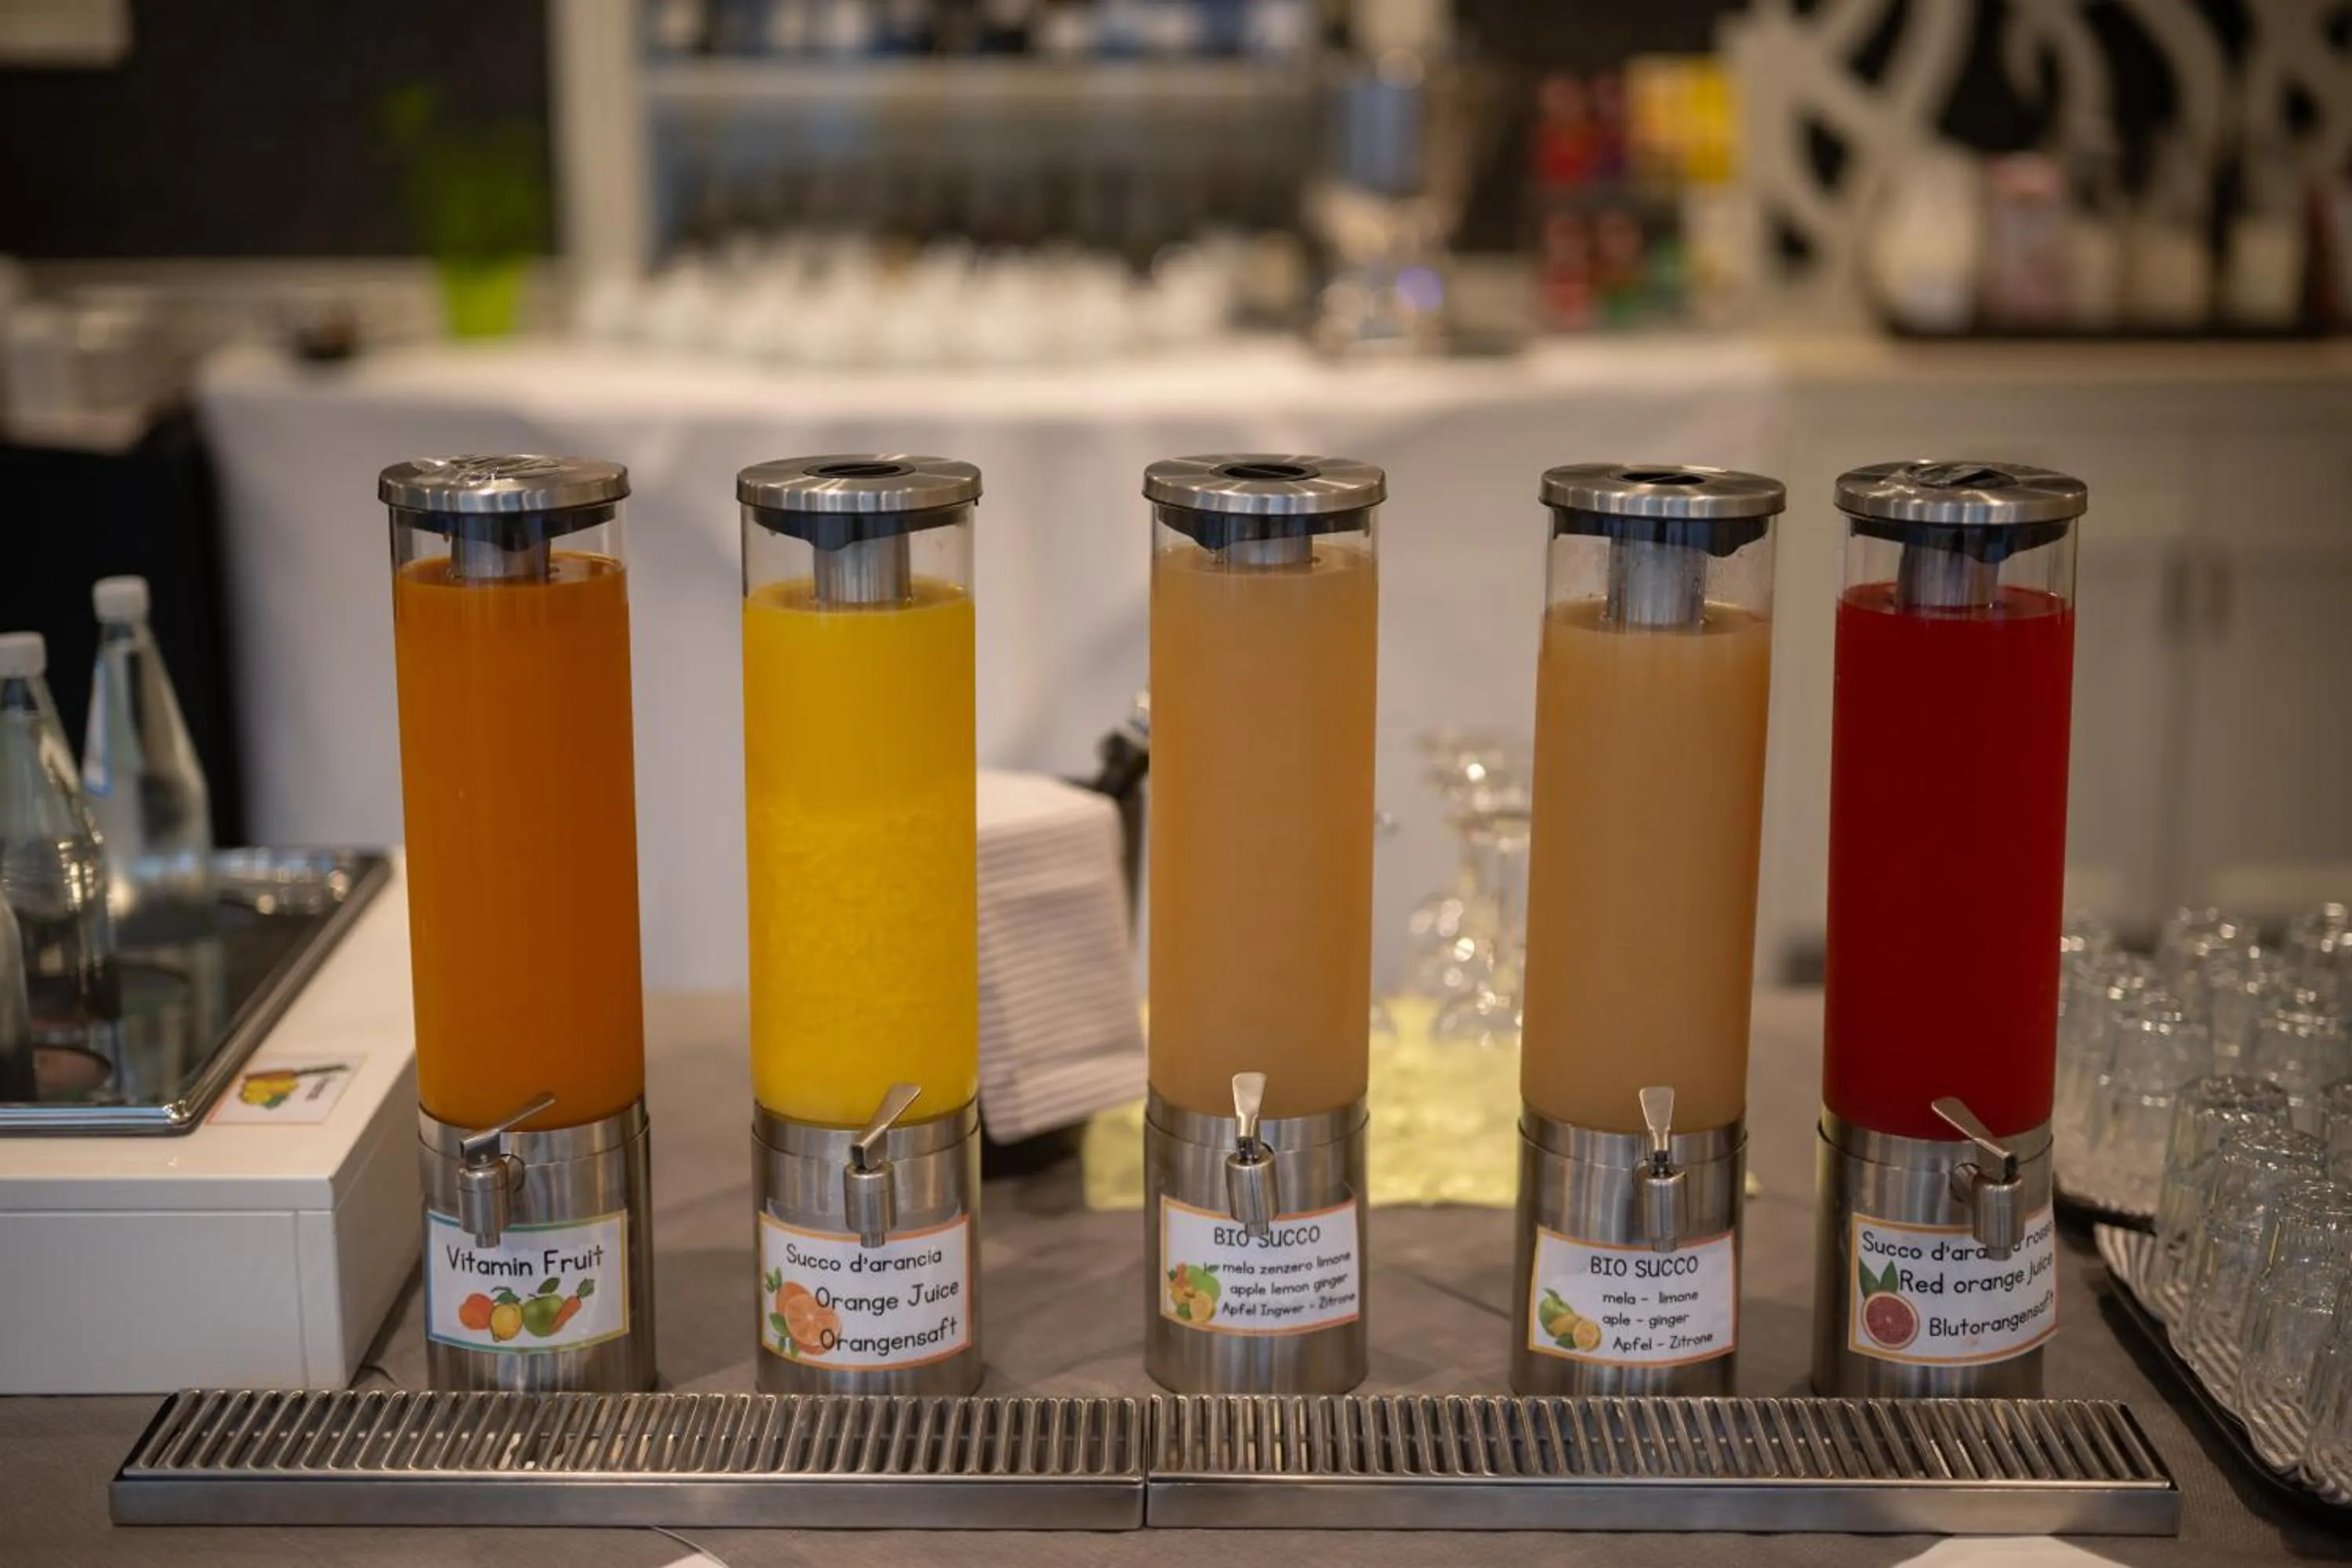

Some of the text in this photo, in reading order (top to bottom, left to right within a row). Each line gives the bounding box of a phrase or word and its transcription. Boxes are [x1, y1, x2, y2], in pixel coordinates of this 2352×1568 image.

[1214, 1226, 1250, 1248] BIO
[1862, 1231, 1922, 1259] Succo
[1931, 1241, 2021, 1261] d'araa
[446, 1244, 604, 1276] Vitamin Fruit
[786, 1243, 942, 1272] Succo d'arancia
[1222, 1252, 1351, 1276] mela zenzero limone
[1590, 1256, 1698, 1278] BIO SUCCO
[1229, 1273, 1348, 1298] apple lemon ginger
[1900, 1269, 1944, 1294] Red
[1954, 1270, 2024, 1293] orange
[815, 1281, 960, 1316] Orange Juice
[1221, 1301, 1257, 1317] Apfel
[1260, 1304, 1304, 1319] Ingwer
[1319, 1293, 1356, 1310] Zitrone
[1602, 1292, 1636, 1305] mela
[1658, 1291, 1699, 1305] limone
[1602, 1312, 1631, 1327] aple
[1649, 1313, 1690, 1329] ginger
[1929, 1290, 2053, 1337] Blutorangensaft
[820, 1316, 957, 1356] Orangensaft
[1613, 1337, 1652, 1353] Apfel
[1670, 1333, 1713, 1349] Zitrone
